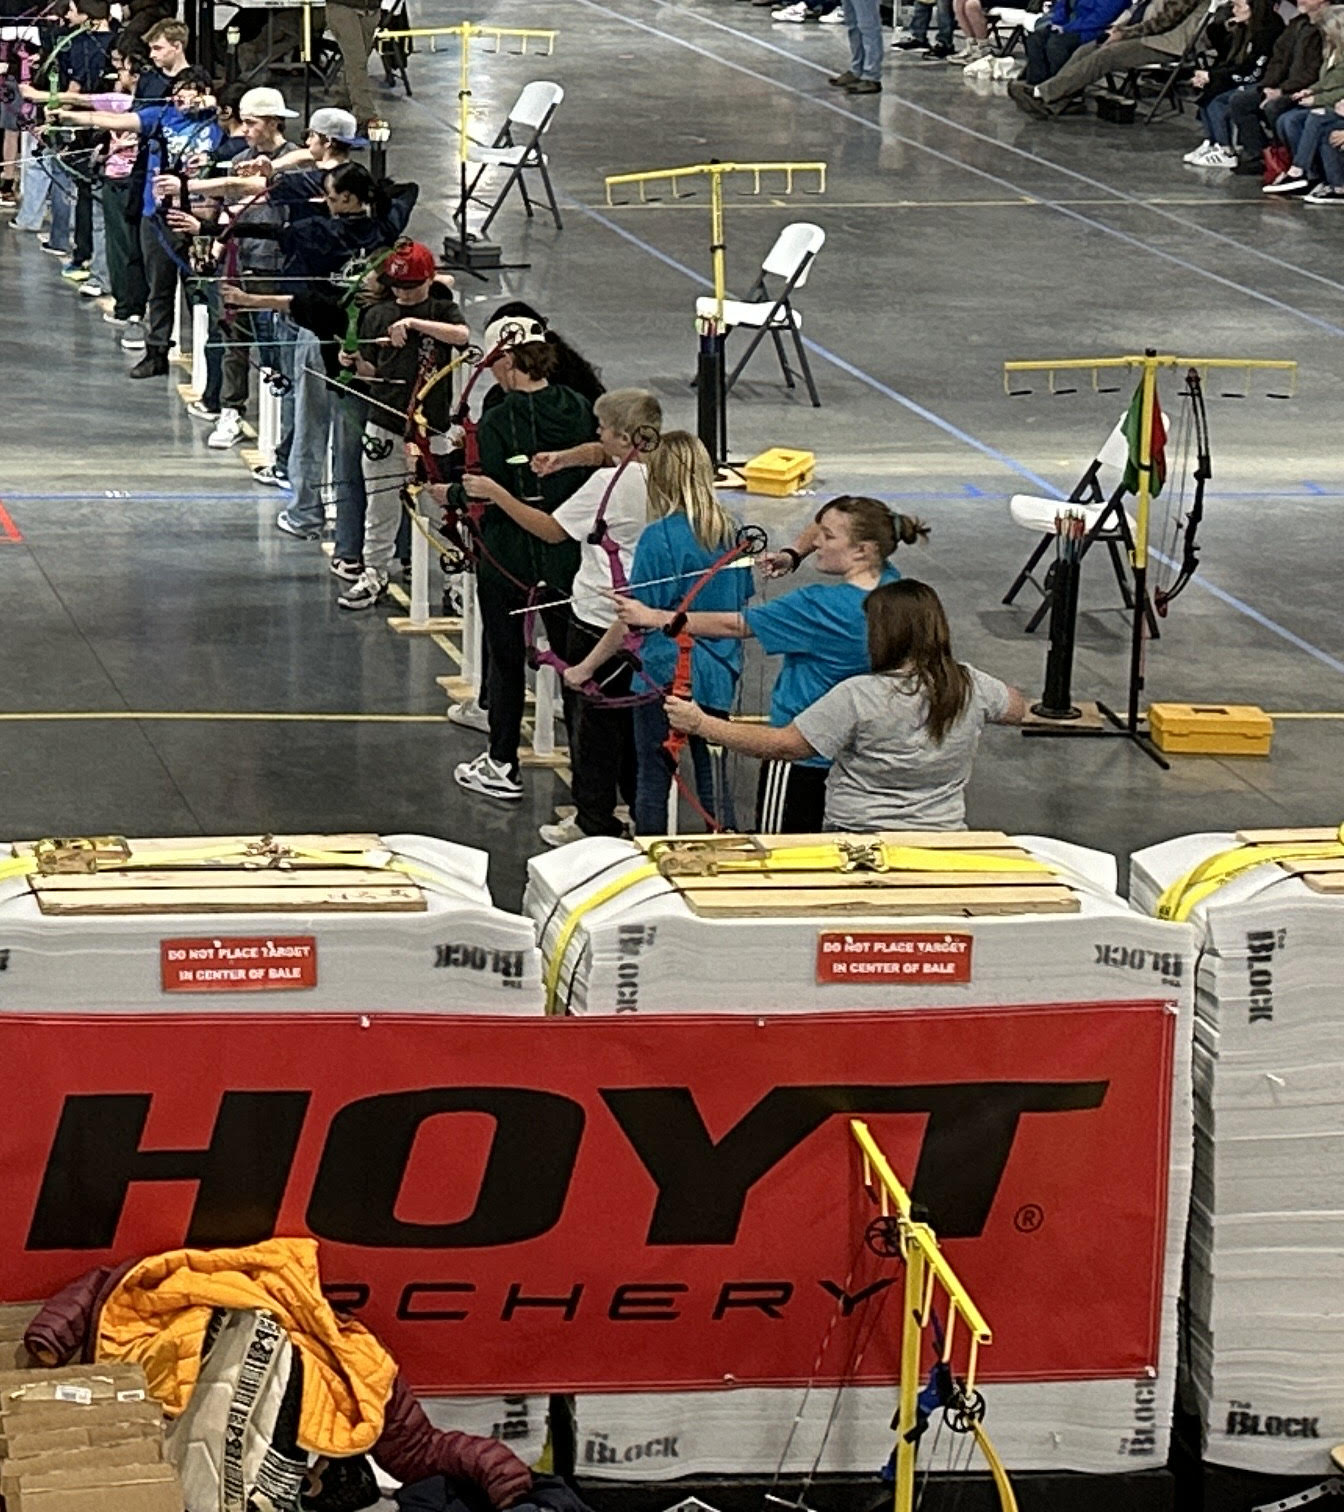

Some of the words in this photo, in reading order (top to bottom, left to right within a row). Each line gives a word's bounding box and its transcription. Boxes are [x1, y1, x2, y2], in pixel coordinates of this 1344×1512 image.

[168, 950, 186, 961] DO
[189, 948, 215, 959] NOT
[218, 947, 259, 959] PLACE
[261, 946, 311, 958] TARGET
[433, 943, 525, 978] BLOCK
[823, 942, 842, 953] DO
[844, 942, 870, 953] NOT
[873, 942, 914, 953] PLACE
[917, 942, 967, 953] TARGET
[1094, 944, 1183, 977] BLOCK
[195, 969, 246, 981] CENTER
[248, 968, 266, 979] OF
[268, 967, 301, 979] BALE
[832, 963, 847, 973] IN
[849, 963, 900, 974] CENTER
[902, 963, 919, 973] OF
[923, 963, 956, 973] BALE
[1247, 929, 1275, 1024] BLOCK
[26, 1081, 1108, 1251] HOYT
[323, 1276, 898, 1324] RCHERY
[1226, 1411, 1320, 1438] BLOCK
[585, 1436, 679, 1465] BLOCK
